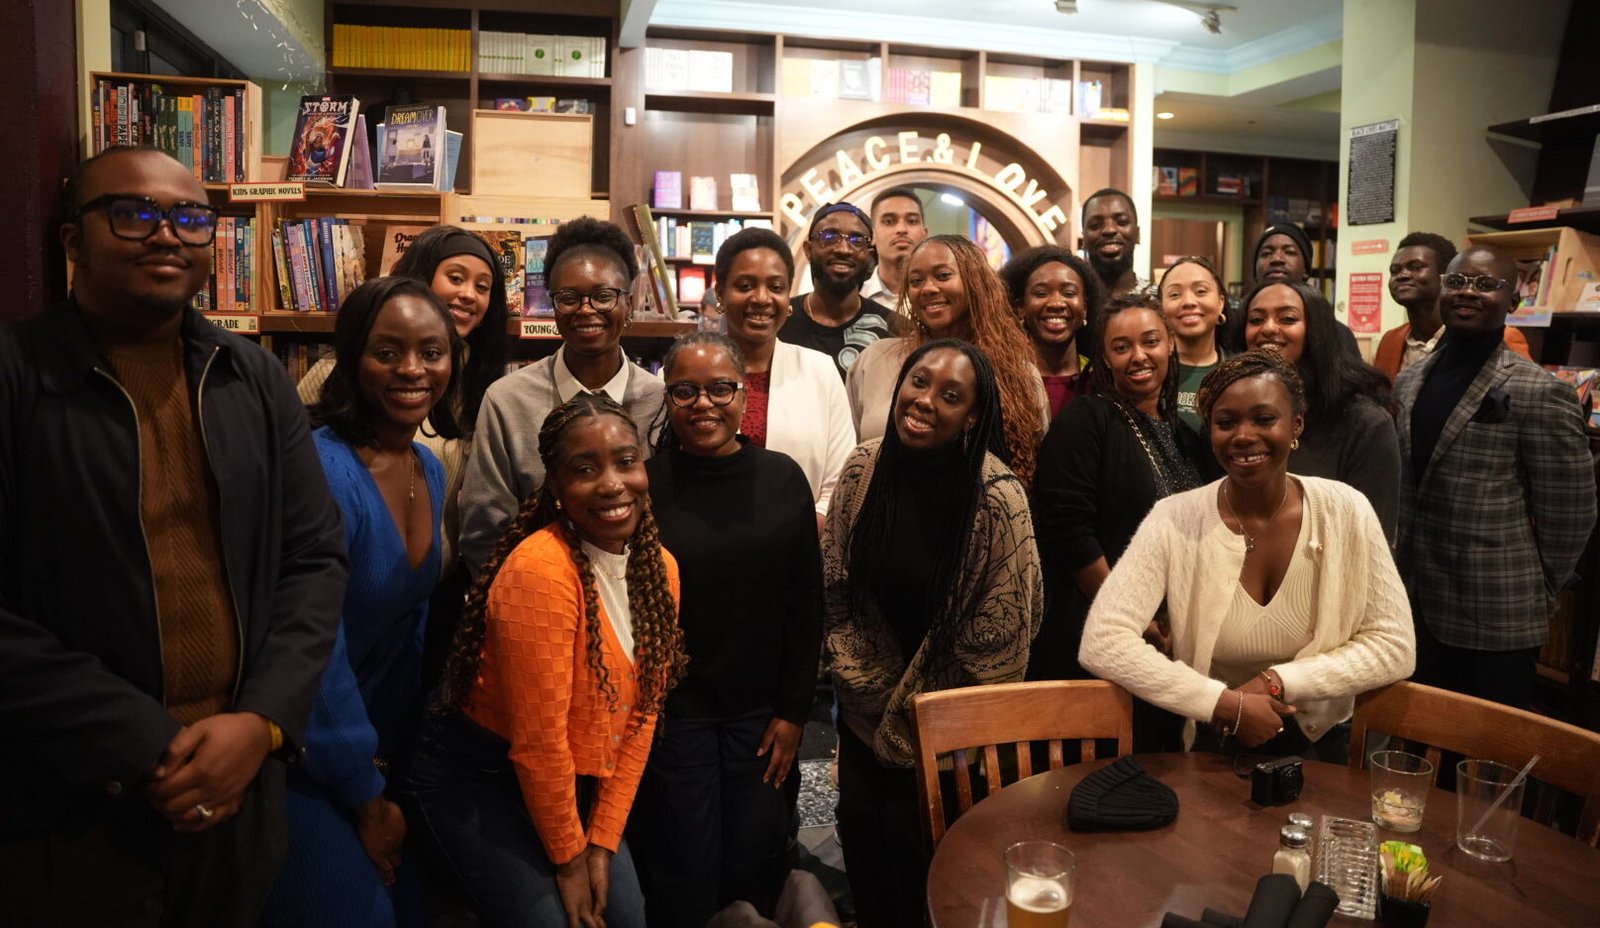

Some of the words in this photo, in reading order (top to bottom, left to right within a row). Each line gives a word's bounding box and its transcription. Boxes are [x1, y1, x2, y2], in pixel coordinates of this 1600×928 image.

[302, 101, 349, 115] STORM
[780, 131, 921, 228] PEACE
[927, 133, 954, 164] &
[232, 188, 248, 196] KIDS
[249, 187, 277, 196] GRAPHIC
[278, 187, 302, 195] NOVELS
[211, 319, 240, 329] GRADE
[523, 324, 552, 335] YOUNG
